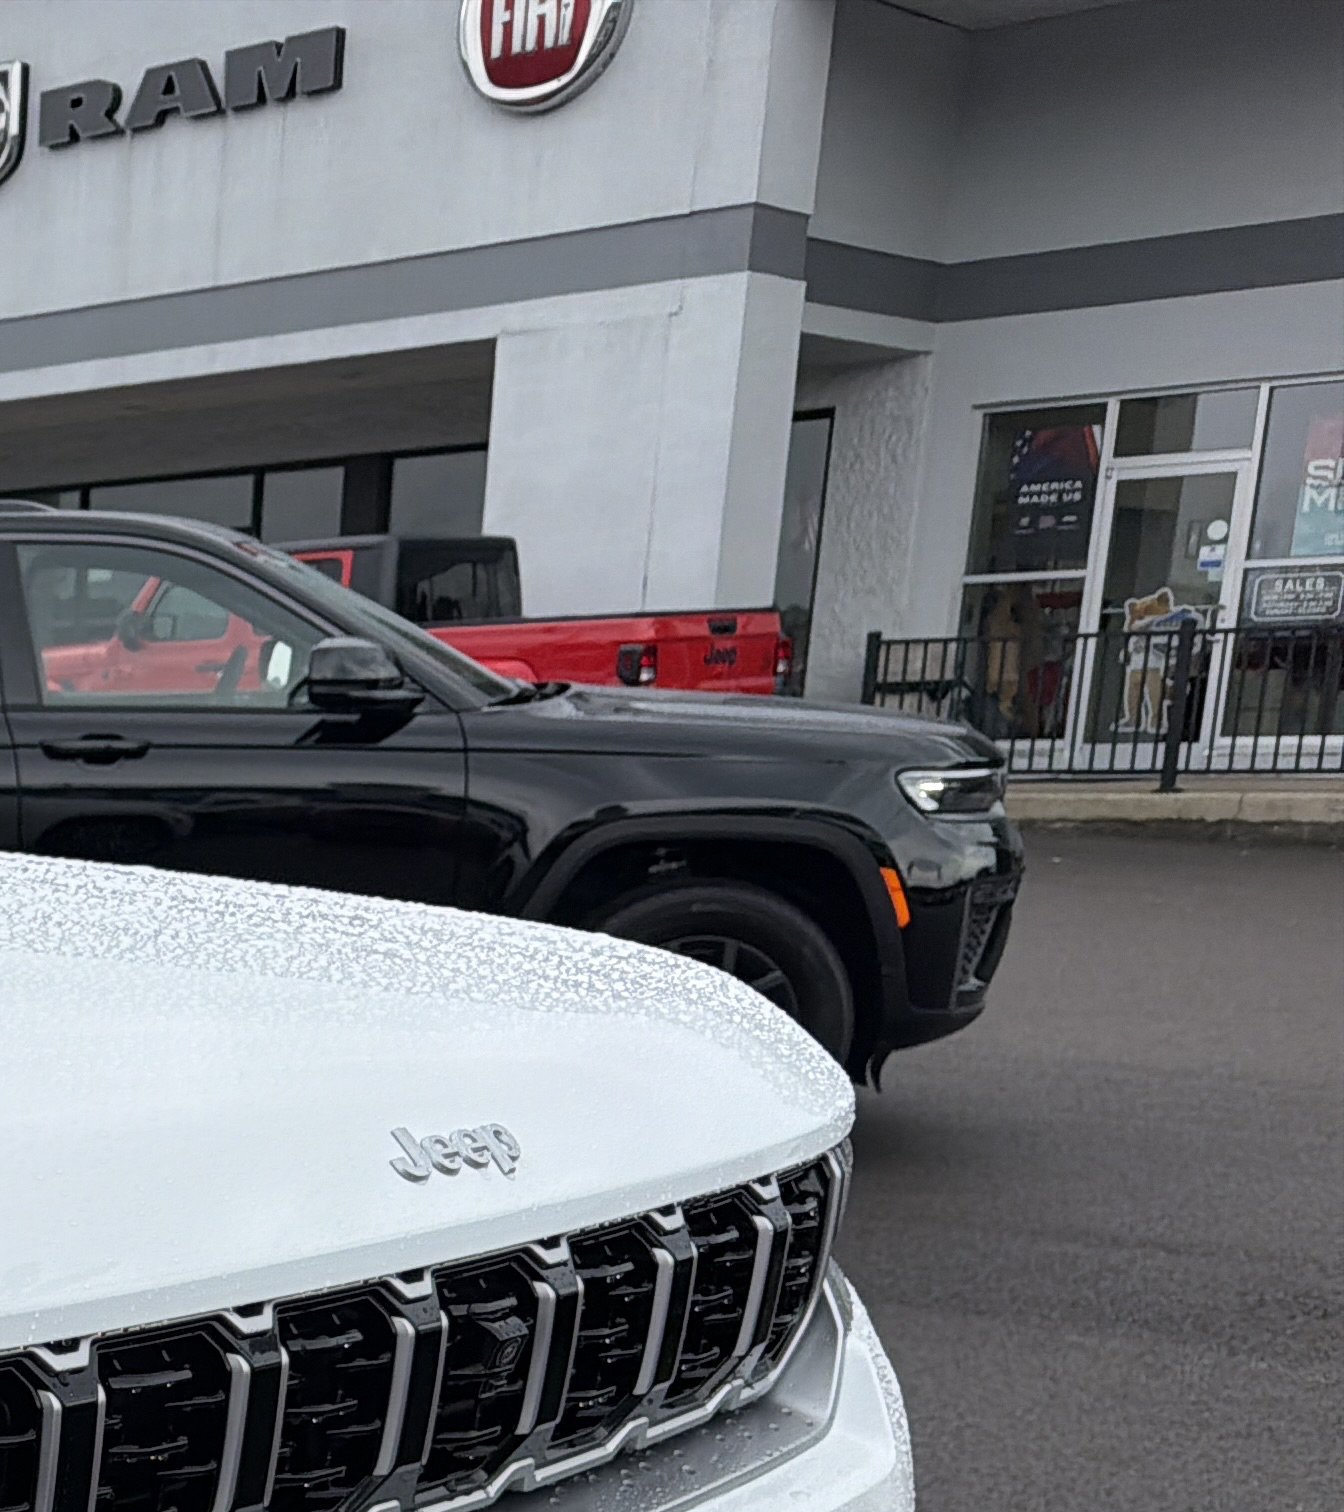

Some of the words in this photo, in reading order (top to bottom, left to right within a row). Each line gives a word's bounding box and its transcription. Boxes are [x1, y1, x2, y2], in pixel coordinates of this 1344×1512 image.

[38, 25, 347, 148] RAM
[1020, 480, 1083, 493] AMERICA
[1018, 493, 1058, 505] MADE
[1062, 491, 1082, 503] US
[1274, 577, 1325, 593] SALES
[703, 640, 737, 667] Jeep
[389, 1123, 521, 1184] Jeep
